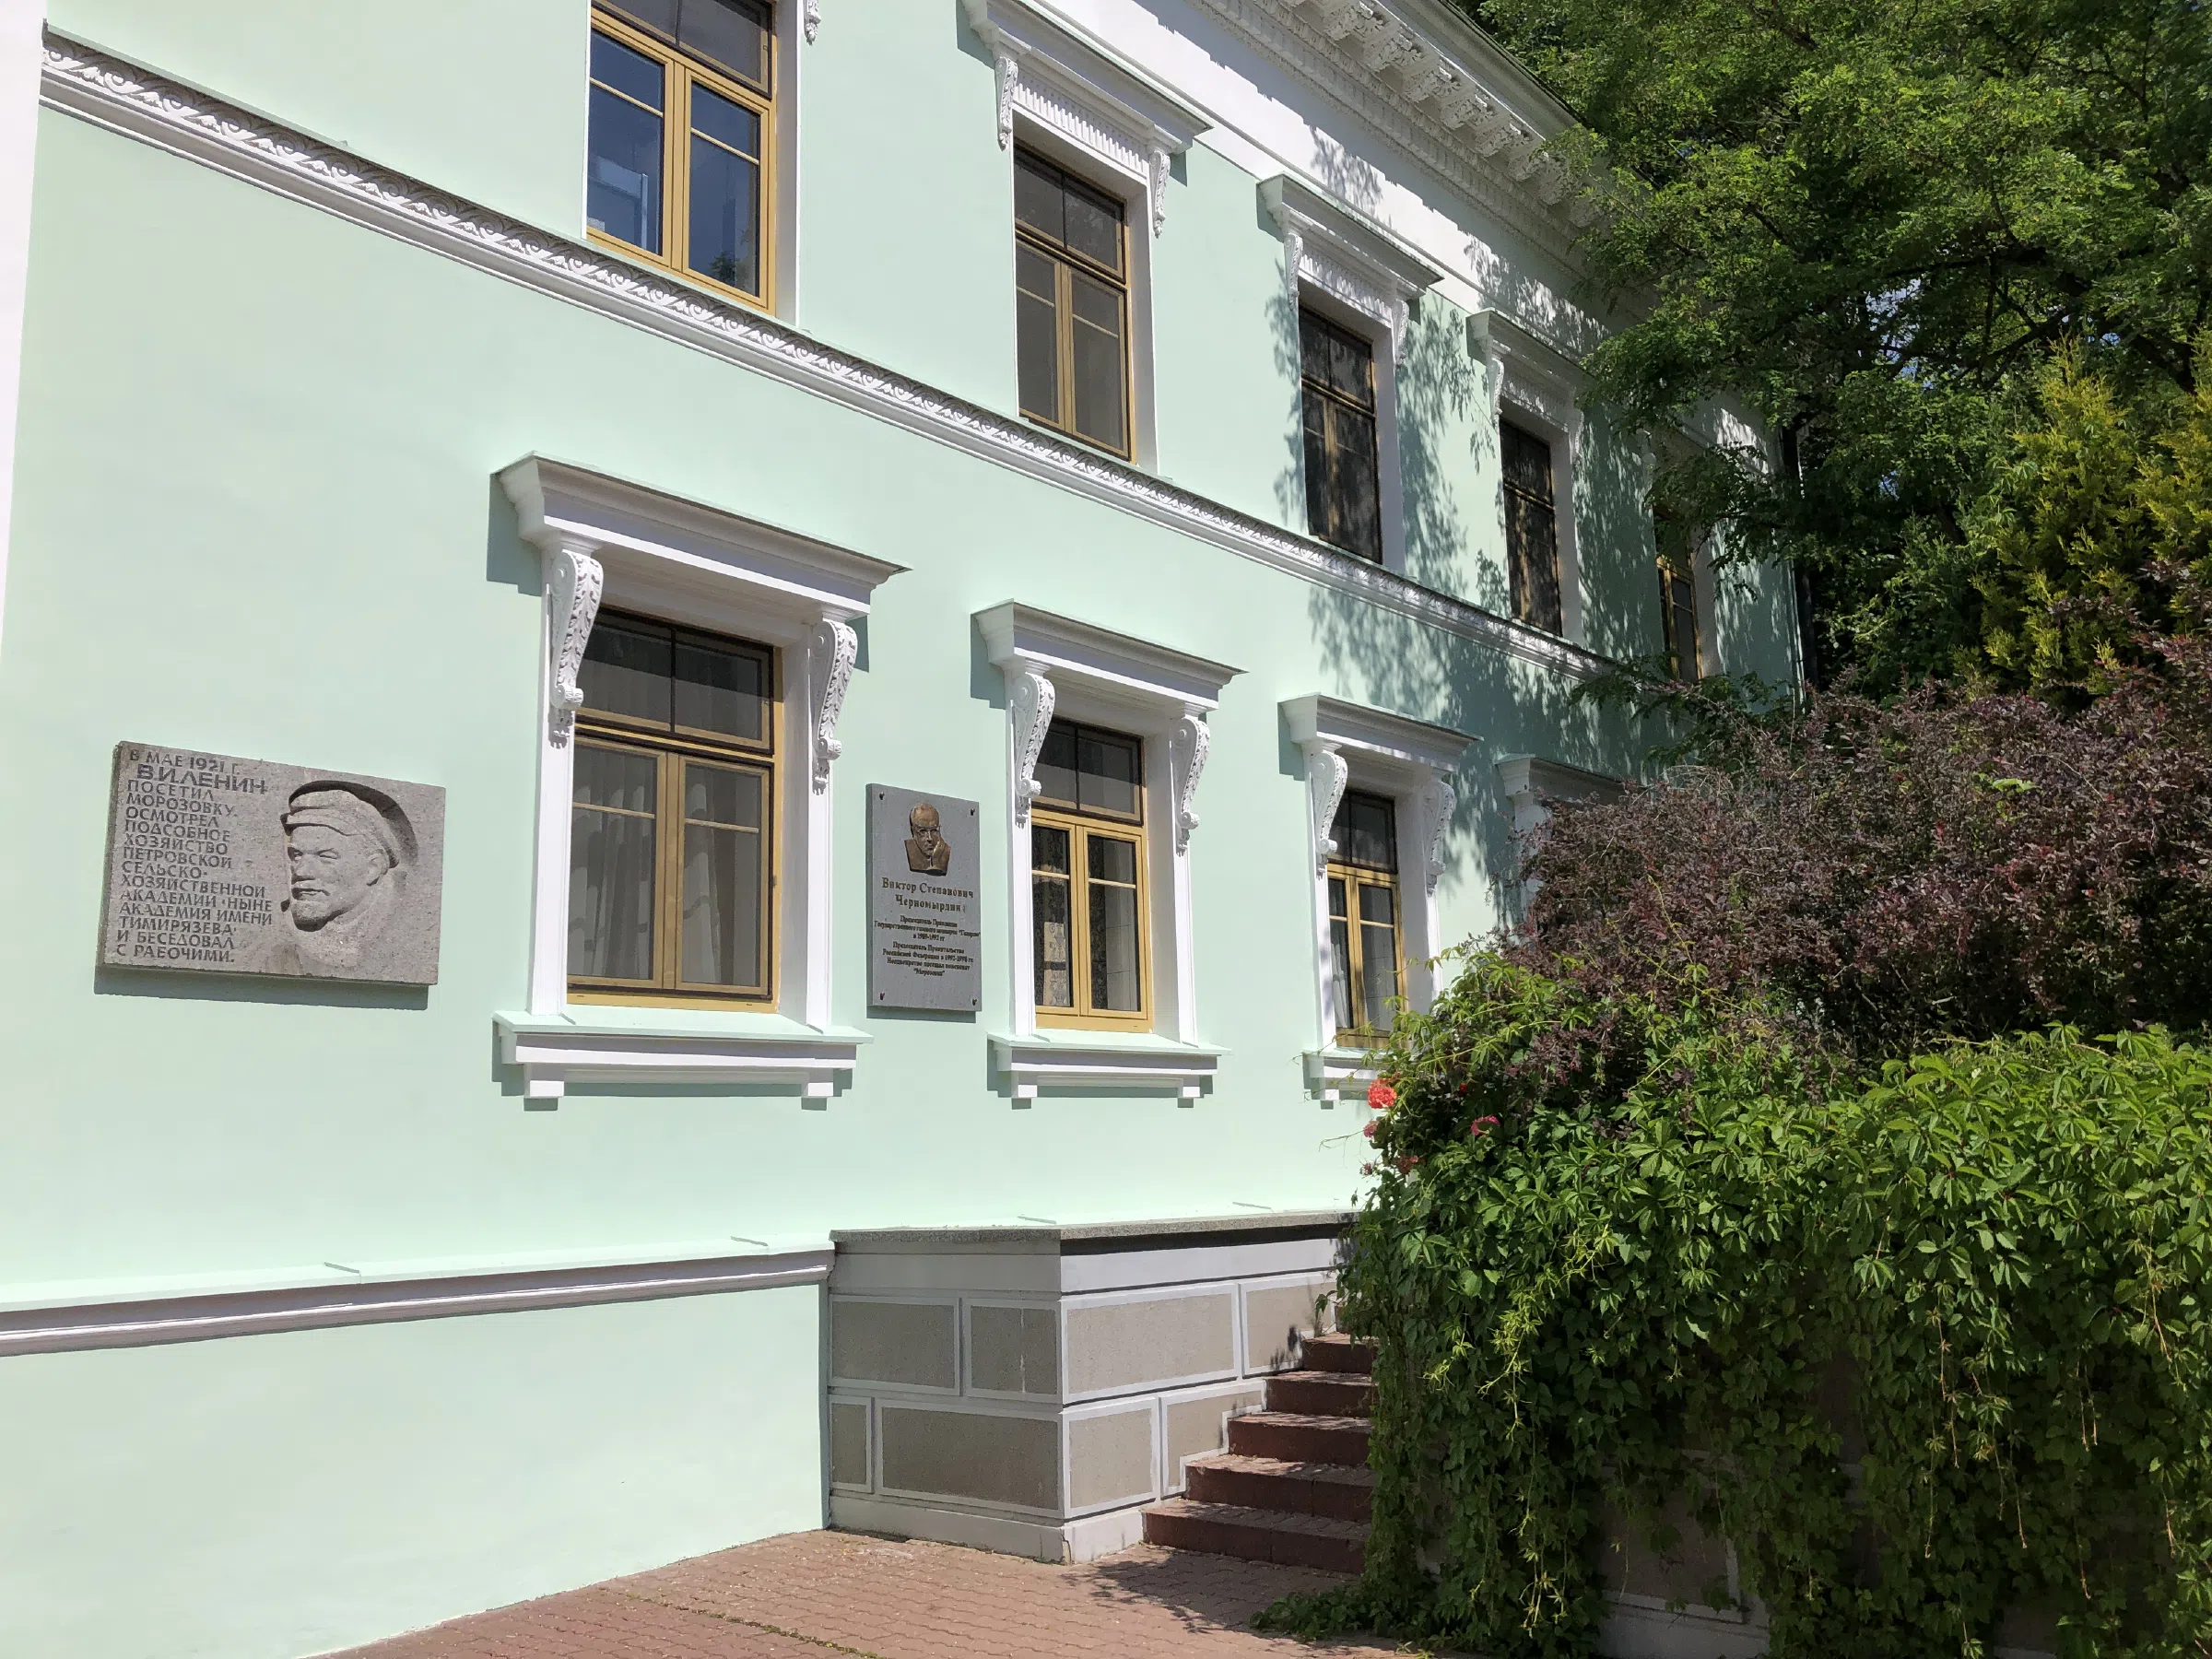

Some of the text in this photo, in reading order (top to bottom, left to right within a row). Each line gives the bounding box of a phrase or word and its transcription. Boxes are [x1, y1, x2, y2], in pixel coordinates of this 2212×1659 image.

[130, 749, 140, 761] В
[146, 751, 182, 767] МАЕ
[190, 757, 224, 772] 1921
[127, 779, 214, 801] ПОСЕТИЛ
[137, 764, 268, 794] В.И.ЛЕНИН
[126, 793, 238, 818] МОРОЗОВКУ.
[126, 806, 220, 828] ОСМОТРЕЛ
[124, 819, 230, 842] ПОДСОБНОЕ
[124, 833, 229, 855] ХОЗЯЙСТВО
[123, 846, 232, 869] ПЕТРОВСКОЙ
[121, 874, 265, 899] ХОЗЯЙСТВЕННОЙ
[882, 877, 974, 899] Виктор Степанович
[119, 888, 217, 908] АКАДЕМИИ
[895, 894, 961, 912] Черномырдин
[119, 902, 272, 926] АКАДЕМИЯ ИМЕНИ
[116, 944, 126, 956] С
[117, 929, 235, 949] И БЕСЕДОВАЛ
